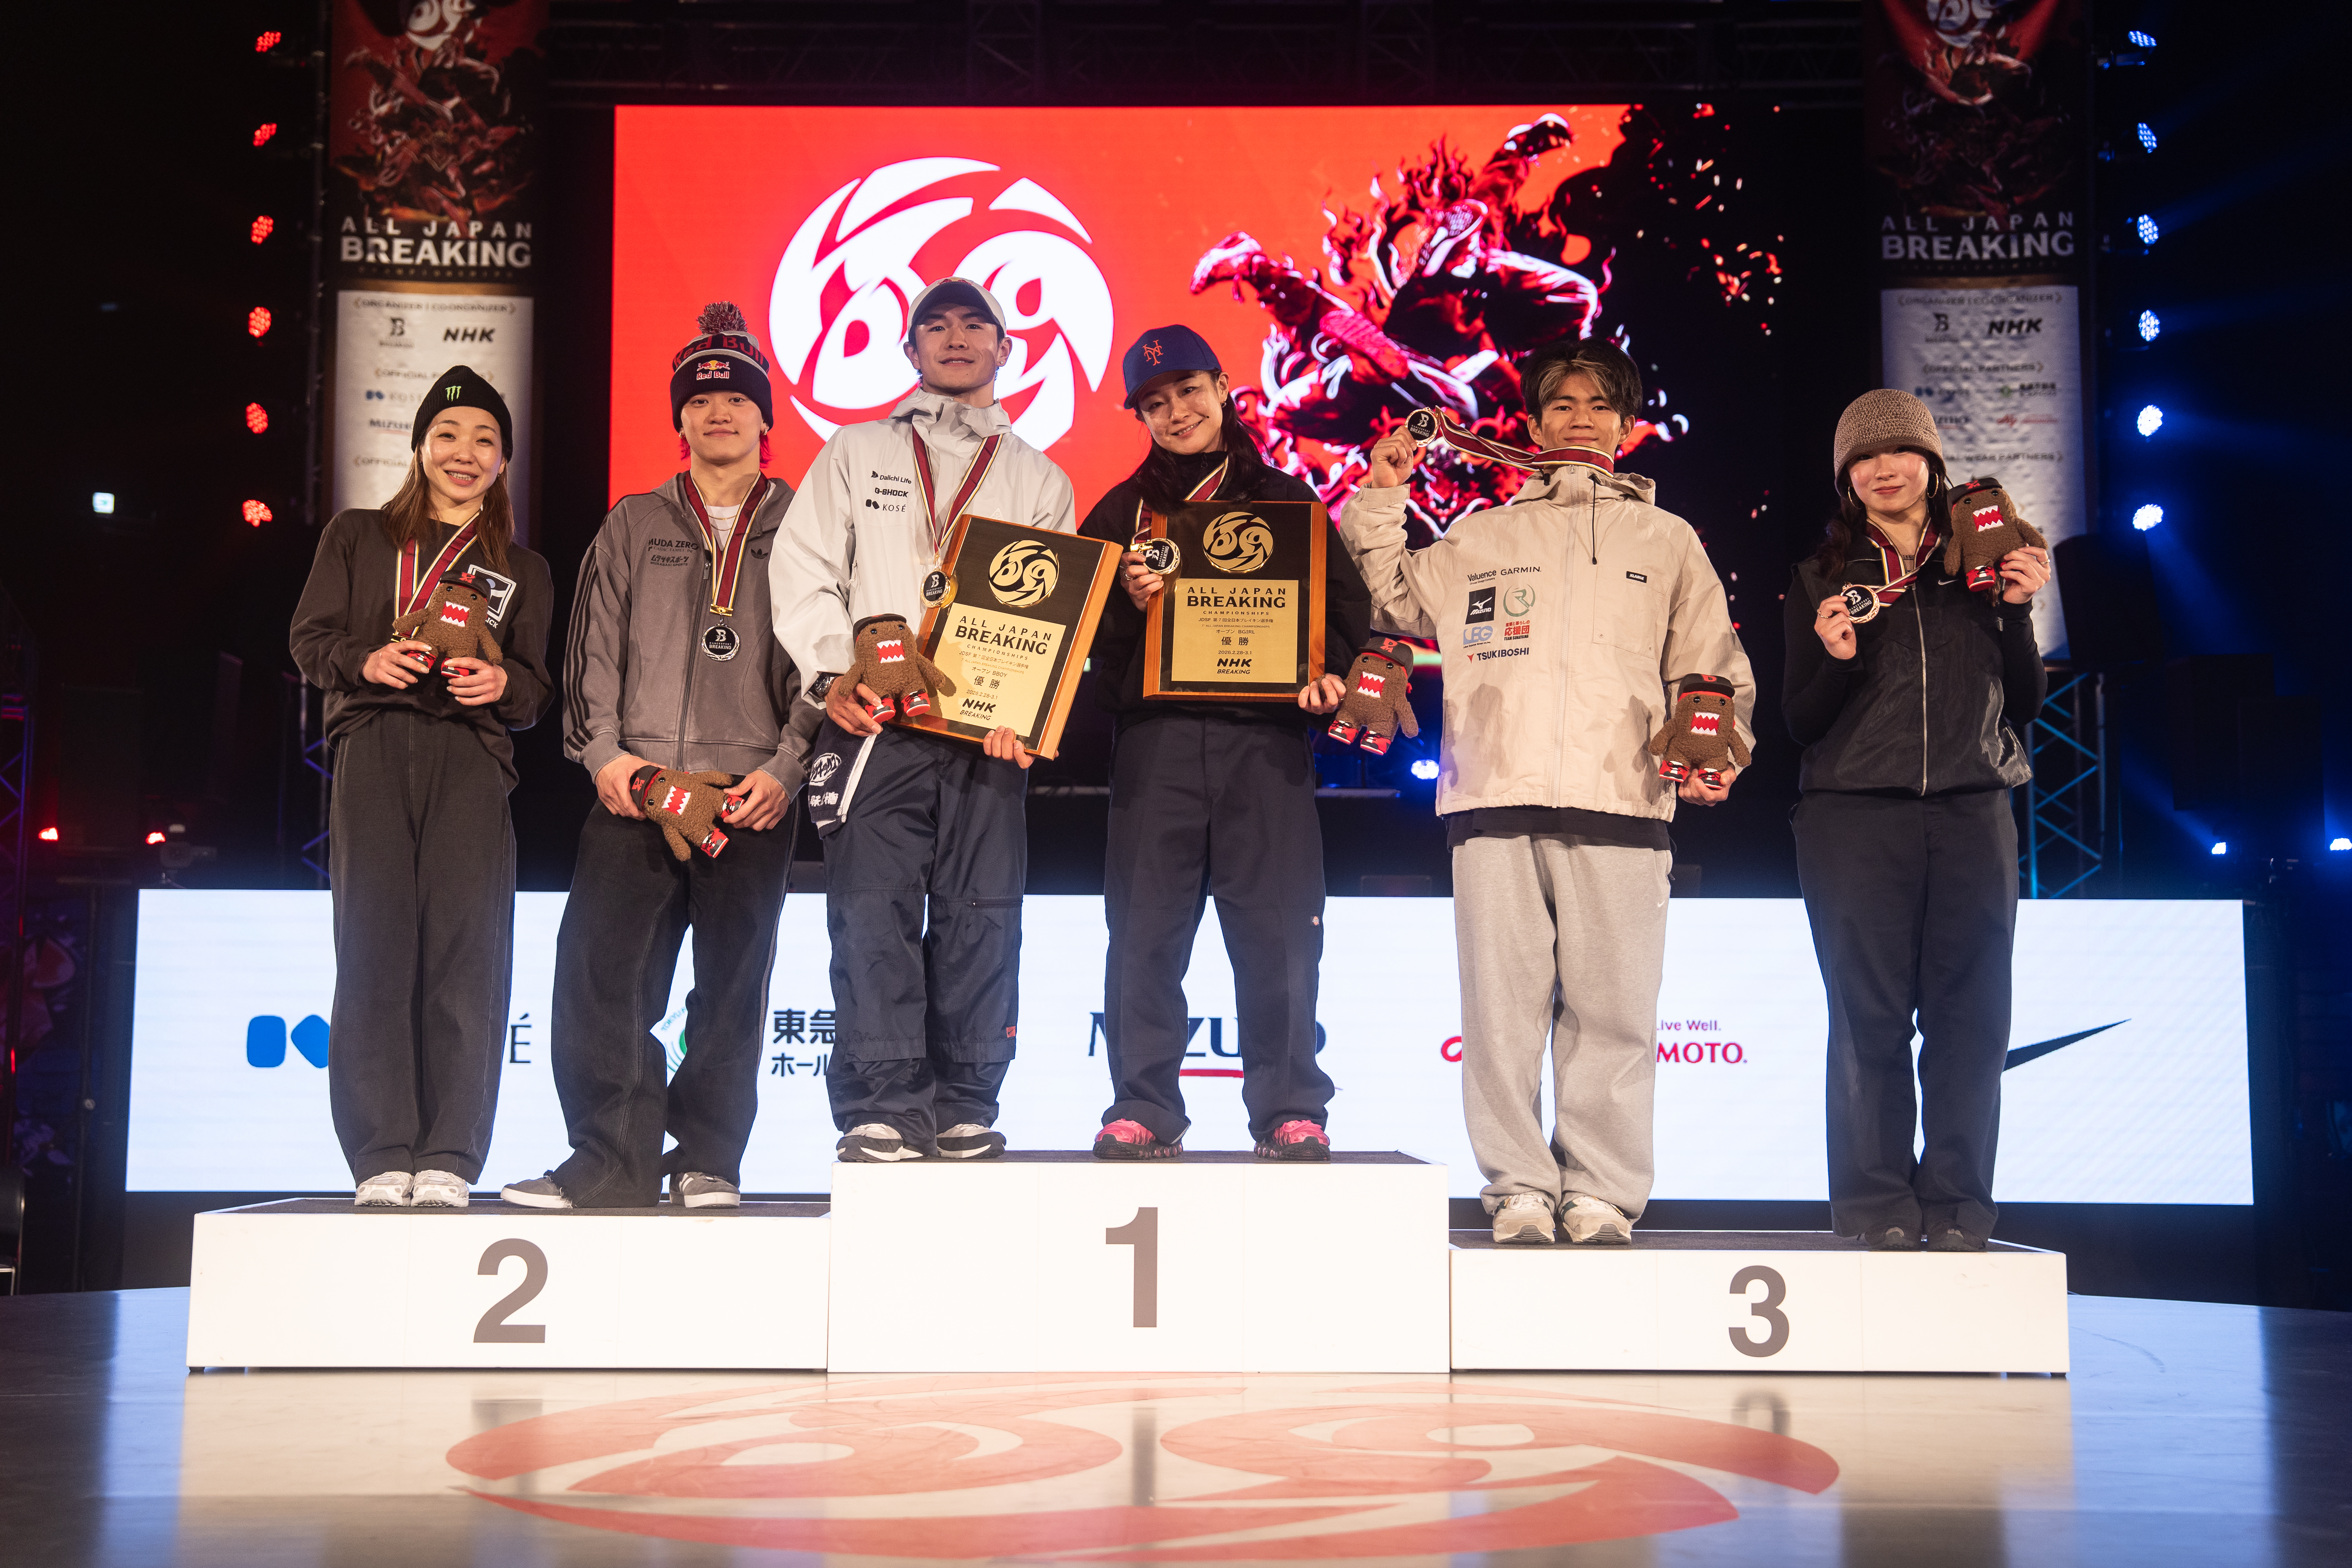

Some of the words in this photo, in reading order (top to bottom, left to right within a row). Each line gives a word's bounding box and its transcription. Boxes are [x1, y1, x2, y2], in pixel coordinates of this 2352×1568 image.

[341, 216, 401, 235] ALL
[423, 219, 532, 237] JAPAN
[1882, 215, 1938, 232] ALL
[1962, 212, 2074, 232] JAPAN
[341, 236, 531, 268] BREAKING
[1882, 231, 2075, 260] BREAKING
[1988, 319, 2042, 334] NHK
[443, 328, 495, 342] NHK
[697, 371, 711, 380] Red
[1410, 427, 1429, 437] BREAKING
[875, 487, 909, 497] G-SHOCK
[675, 540, 699, 550] ZERO
[651, 554, 689, 563] ムラサキスポーツ
[1161, 546, 1169, 568] BREAKING
[1467, 570, 1496, 581] Valuence
[1187, 595, 1286, 608] BREAKING
[1851, 600, 1872, 615] BREAKING
[1470, 607, 1492, 615] MIZUNO
[485, 617, 499, 629] ICK
[959, 616, 987, 628] ALL
[999, 624, 1052, 641] JAPAN
[1504, 625, 1530, 636] 応援団
[955, 625, 1047, 655] BREAKING
[1221, 637, 1249, 646] 優勝
[967, 644, 1028, 660] CHAMPIONSHIPS
[1477, 648, 1530, 661] TSUKIBOSHI
[1217, 658, 1252, 667] NHK
[998, 666, 1024, 674] CHAMPIONSHIPS
[974, 675, 1000, 689] 優勝
[966, 690, 998, 700] 2026.2.28-3.1
[962, 698, 996, 713] NHK
[960, 710, 991, 720] BREAKING
[1657, 1020, 1681, 1031] ive
[1686, 1020, 1721, 1031] Well.
[1106, 1207, 1158, 1328] 1
[474, 1238, 548, 1343] 2
[1729, 1265, 1789, 1357] 3
